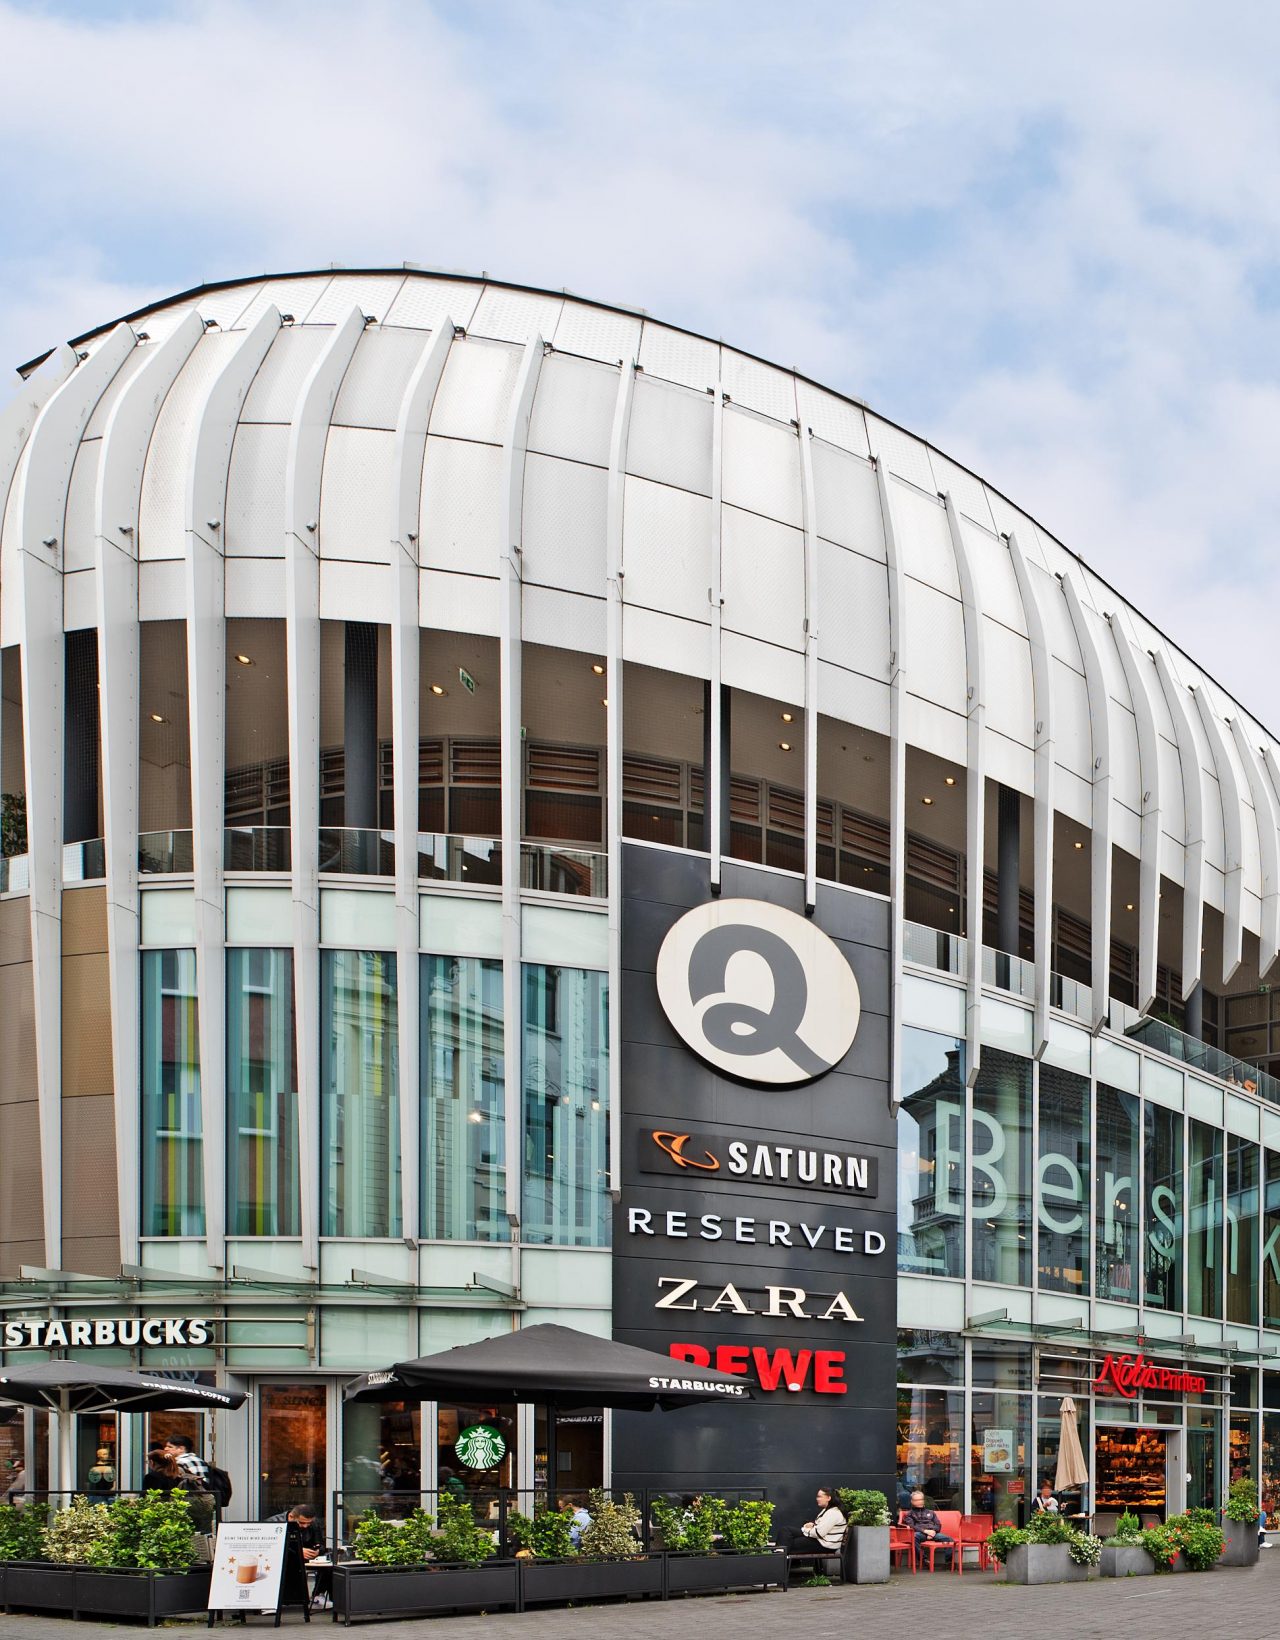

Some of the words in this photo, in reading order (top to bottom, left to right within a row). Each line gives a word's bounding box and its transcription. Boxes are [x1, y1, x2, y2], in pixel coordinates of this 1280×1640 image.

[728, 1141, 868, 1189] SATURN
[628, 1208, 886, 1254] RESERVED
[655, 1277, 864, 1321] ZARA
[5, 1319, 209, 1346] STARBUCKS
[649, 1377, 745, 1395] STARBUCKS
[1161, 1368, 1206, 1393] Printen
